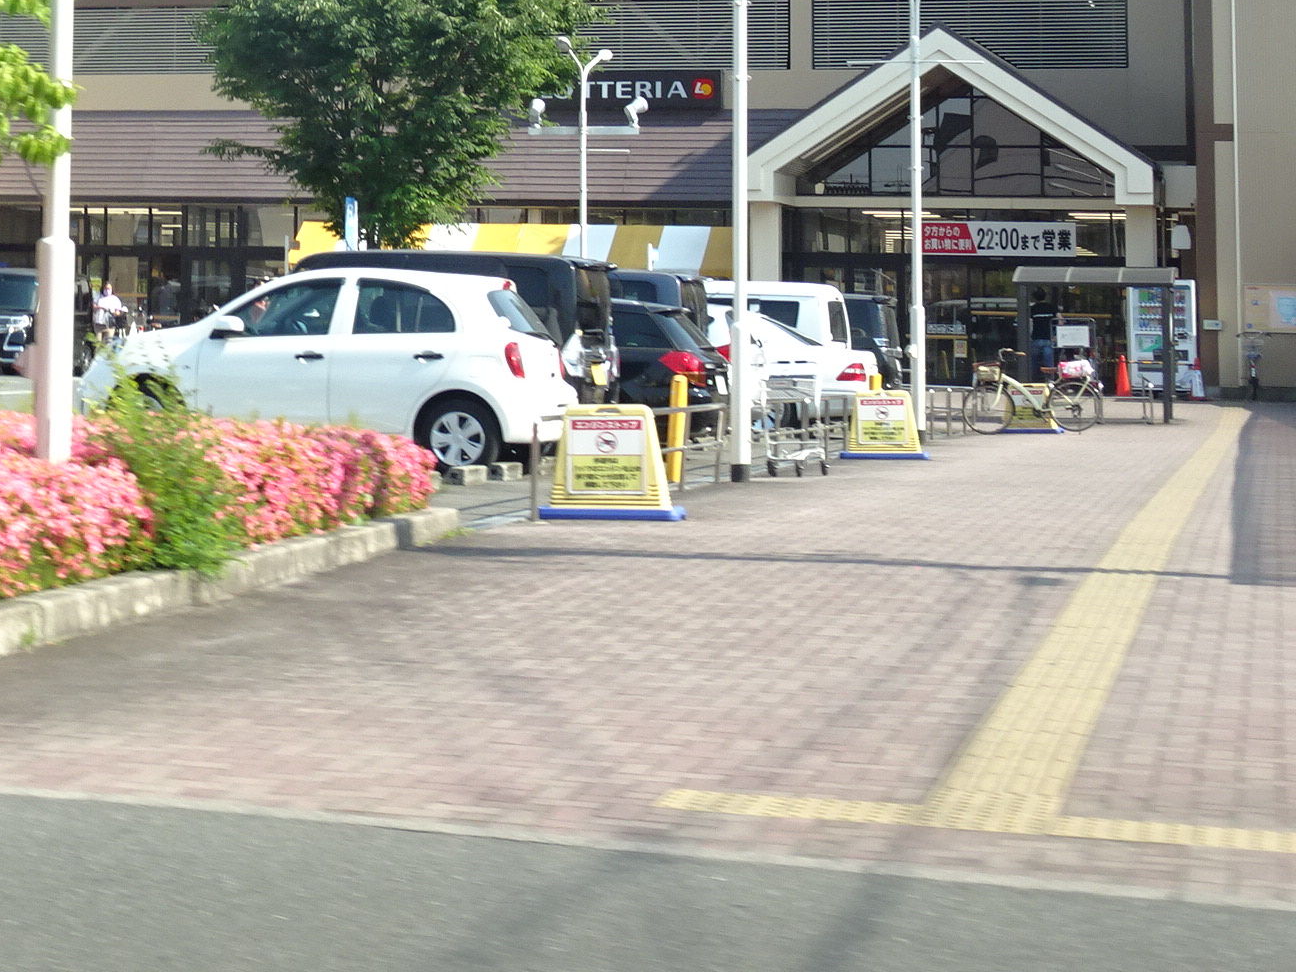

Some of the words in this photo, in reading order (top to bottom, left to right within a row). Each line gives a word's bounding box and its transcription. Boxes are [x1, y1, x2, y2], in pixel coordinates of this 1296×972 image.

[924, 225, 960, 237] 夕方からの
[976, 227, 1072, 251] 22:00まで営業
